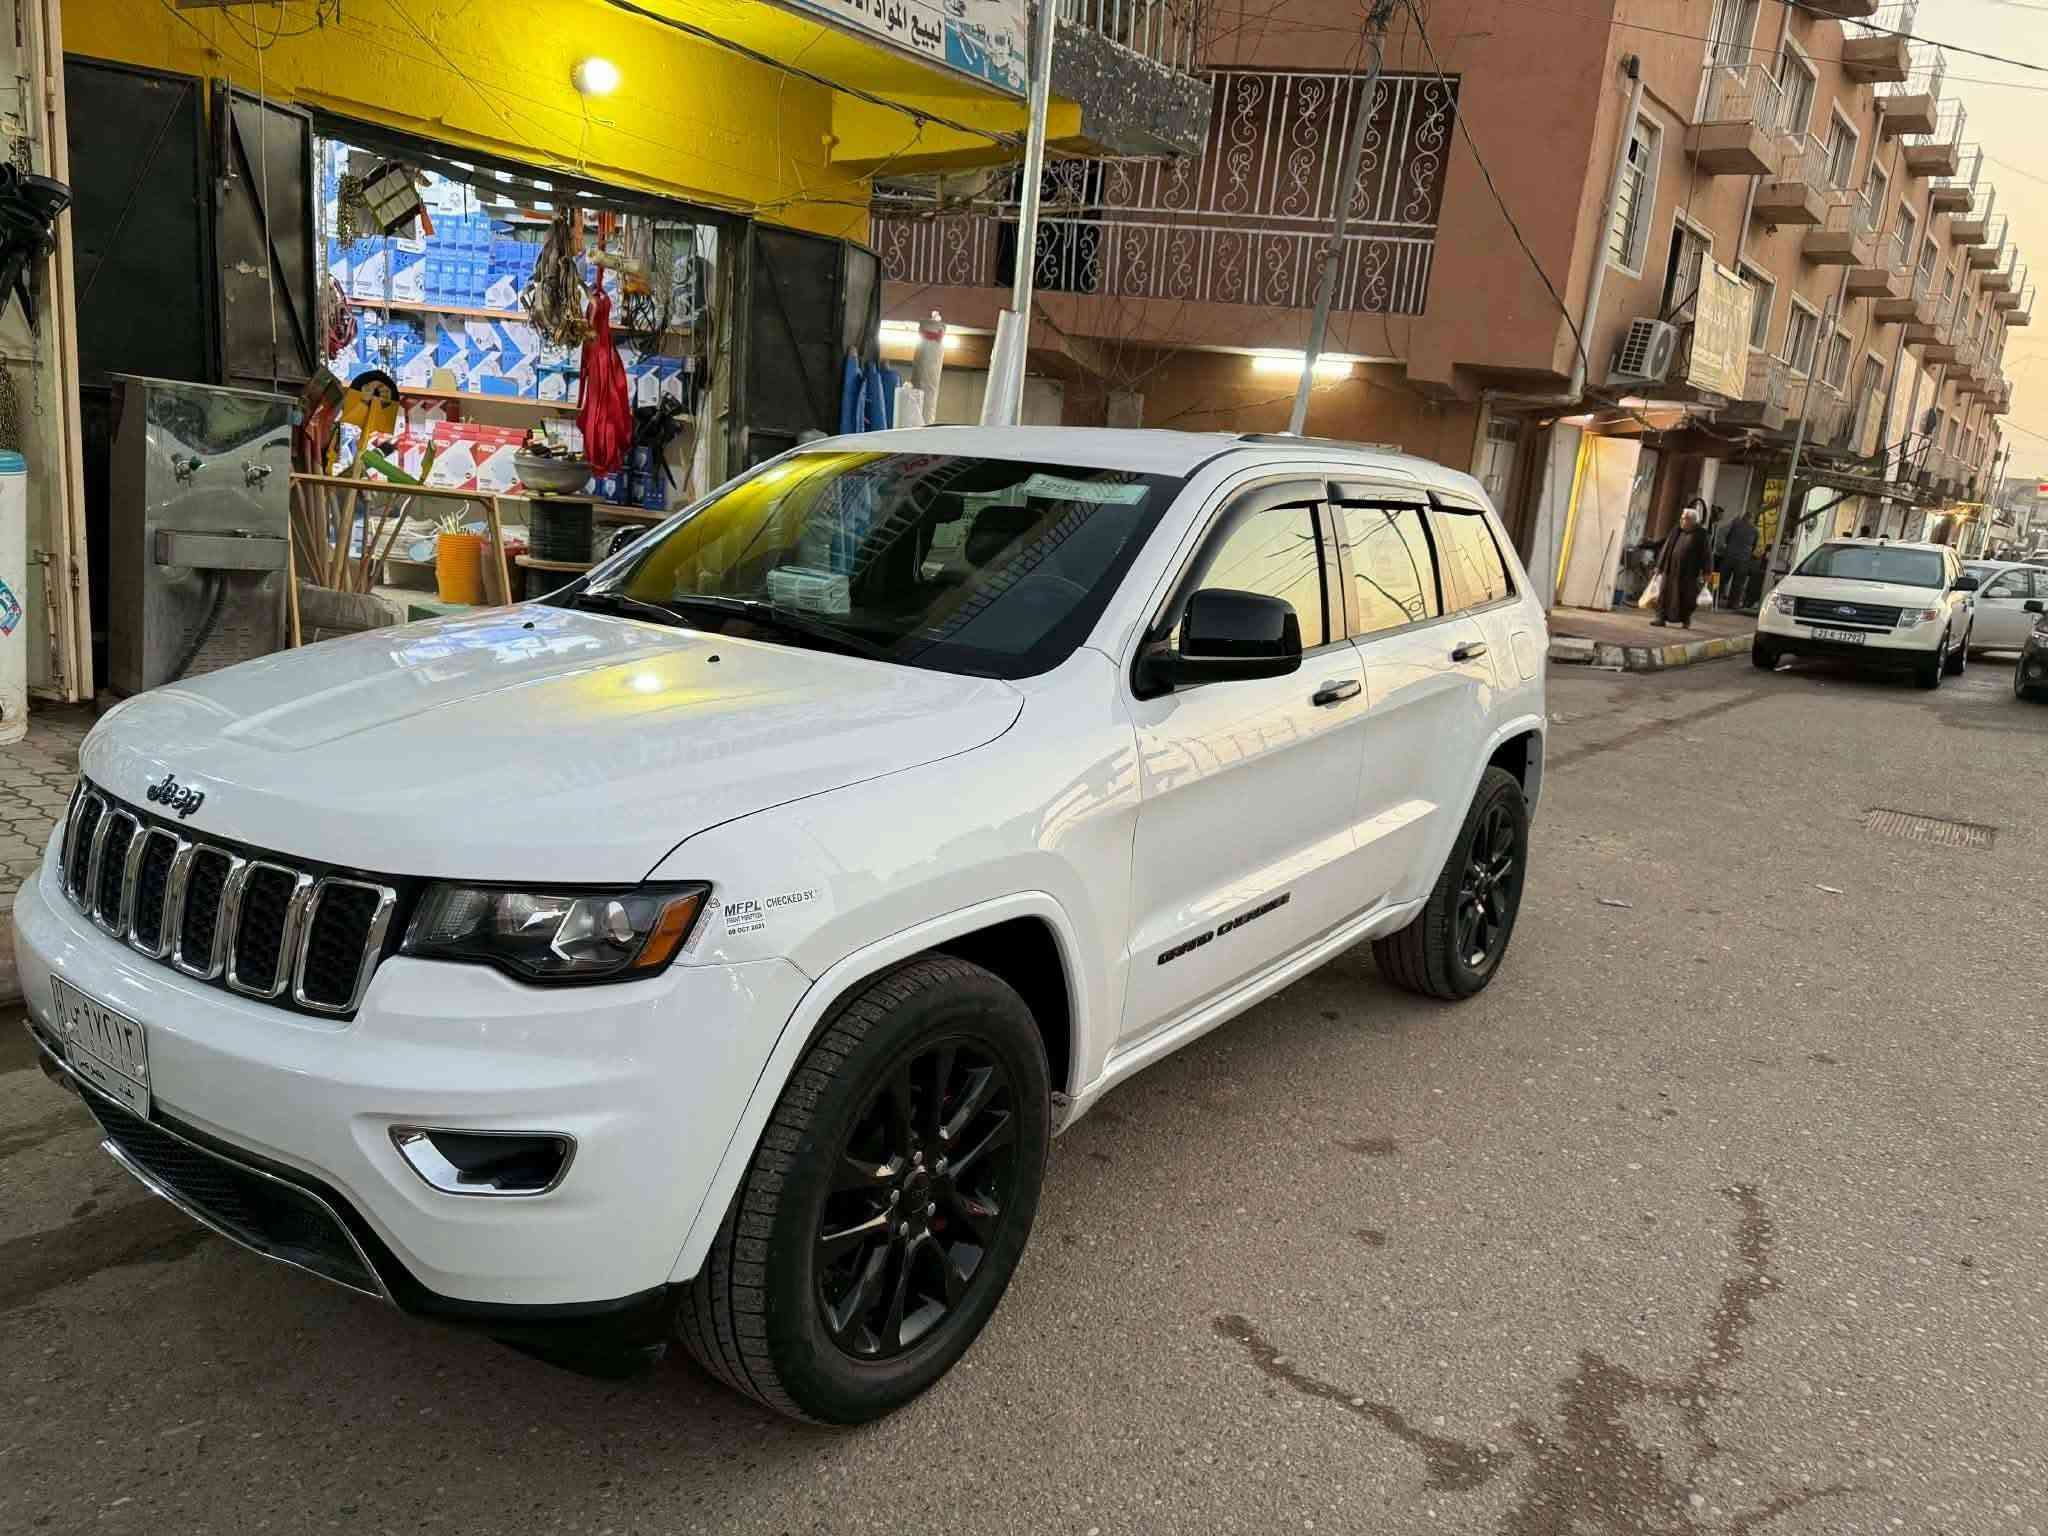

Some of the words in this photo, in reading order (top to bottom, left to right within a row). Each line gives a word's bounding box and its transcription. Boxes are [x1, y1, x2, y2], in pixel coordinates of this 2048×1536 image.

[911, 14, 943, 50] لبيع
[147, 774, 205, 819] Jeep
[724, 899, 762, 917] MFPL
[766, 893, 803, 908] CHECKED
[737, 926, 749, 934] OCT
